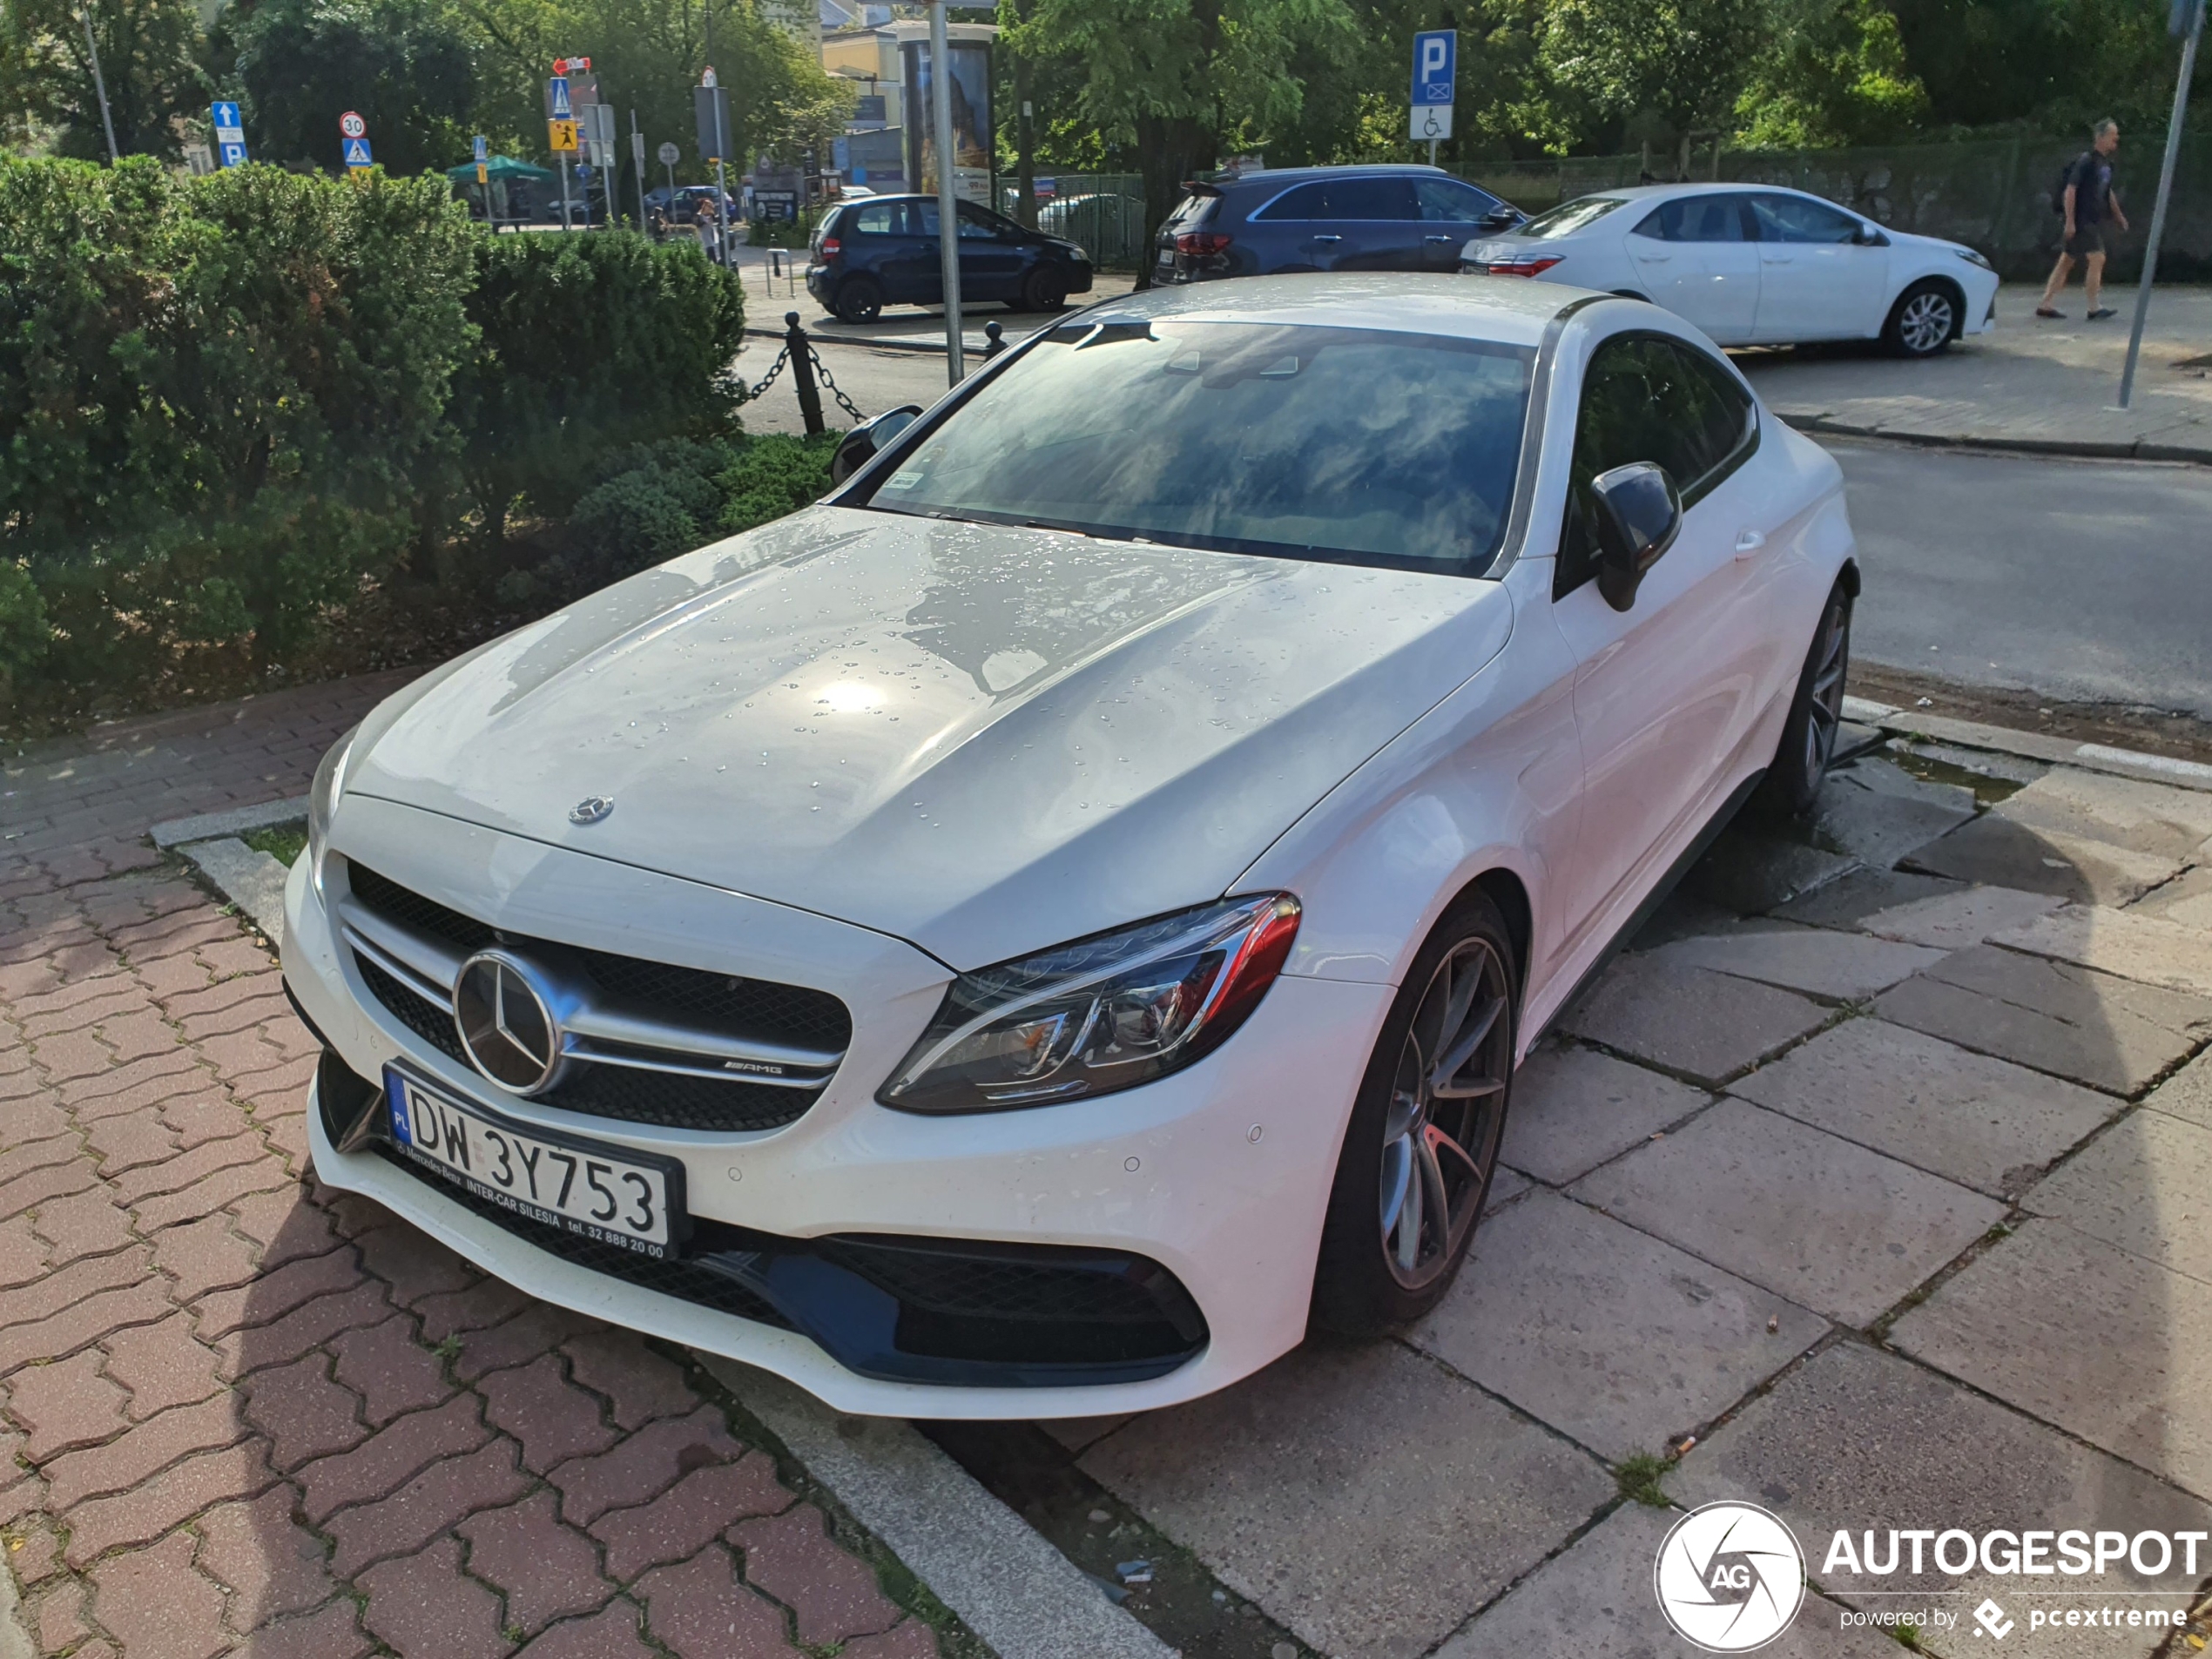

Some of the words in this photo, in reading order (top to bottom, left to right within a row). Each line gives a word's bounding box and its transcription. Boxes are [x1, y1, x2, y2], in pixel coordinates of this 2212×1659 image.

[1421, 37, 1447, 84] P
[344, 118, 362, 132] 30
[226, 145, 242, 165] P
[743, 1063, 782, 1075] AMG
[394, 1111, 408, 1131] PL
[410, 1088, 471, 1172] DW
[484, 1130, 655, 1233] 3Y753
[406, 1146, 462, 1185] Mercedes-Benz
[467, 1179, 517, 1211] INTER-CAR
[519, 1203, 561, 1228] SILESIA
[568, 1221, 585, 1235] tel.
[588, 1226, 603, 1240] 32
[605, 1232, 627, 1248] 888
[631, 1239, 645, 1253] 20
[648, 1244, 664, 1258] 00
